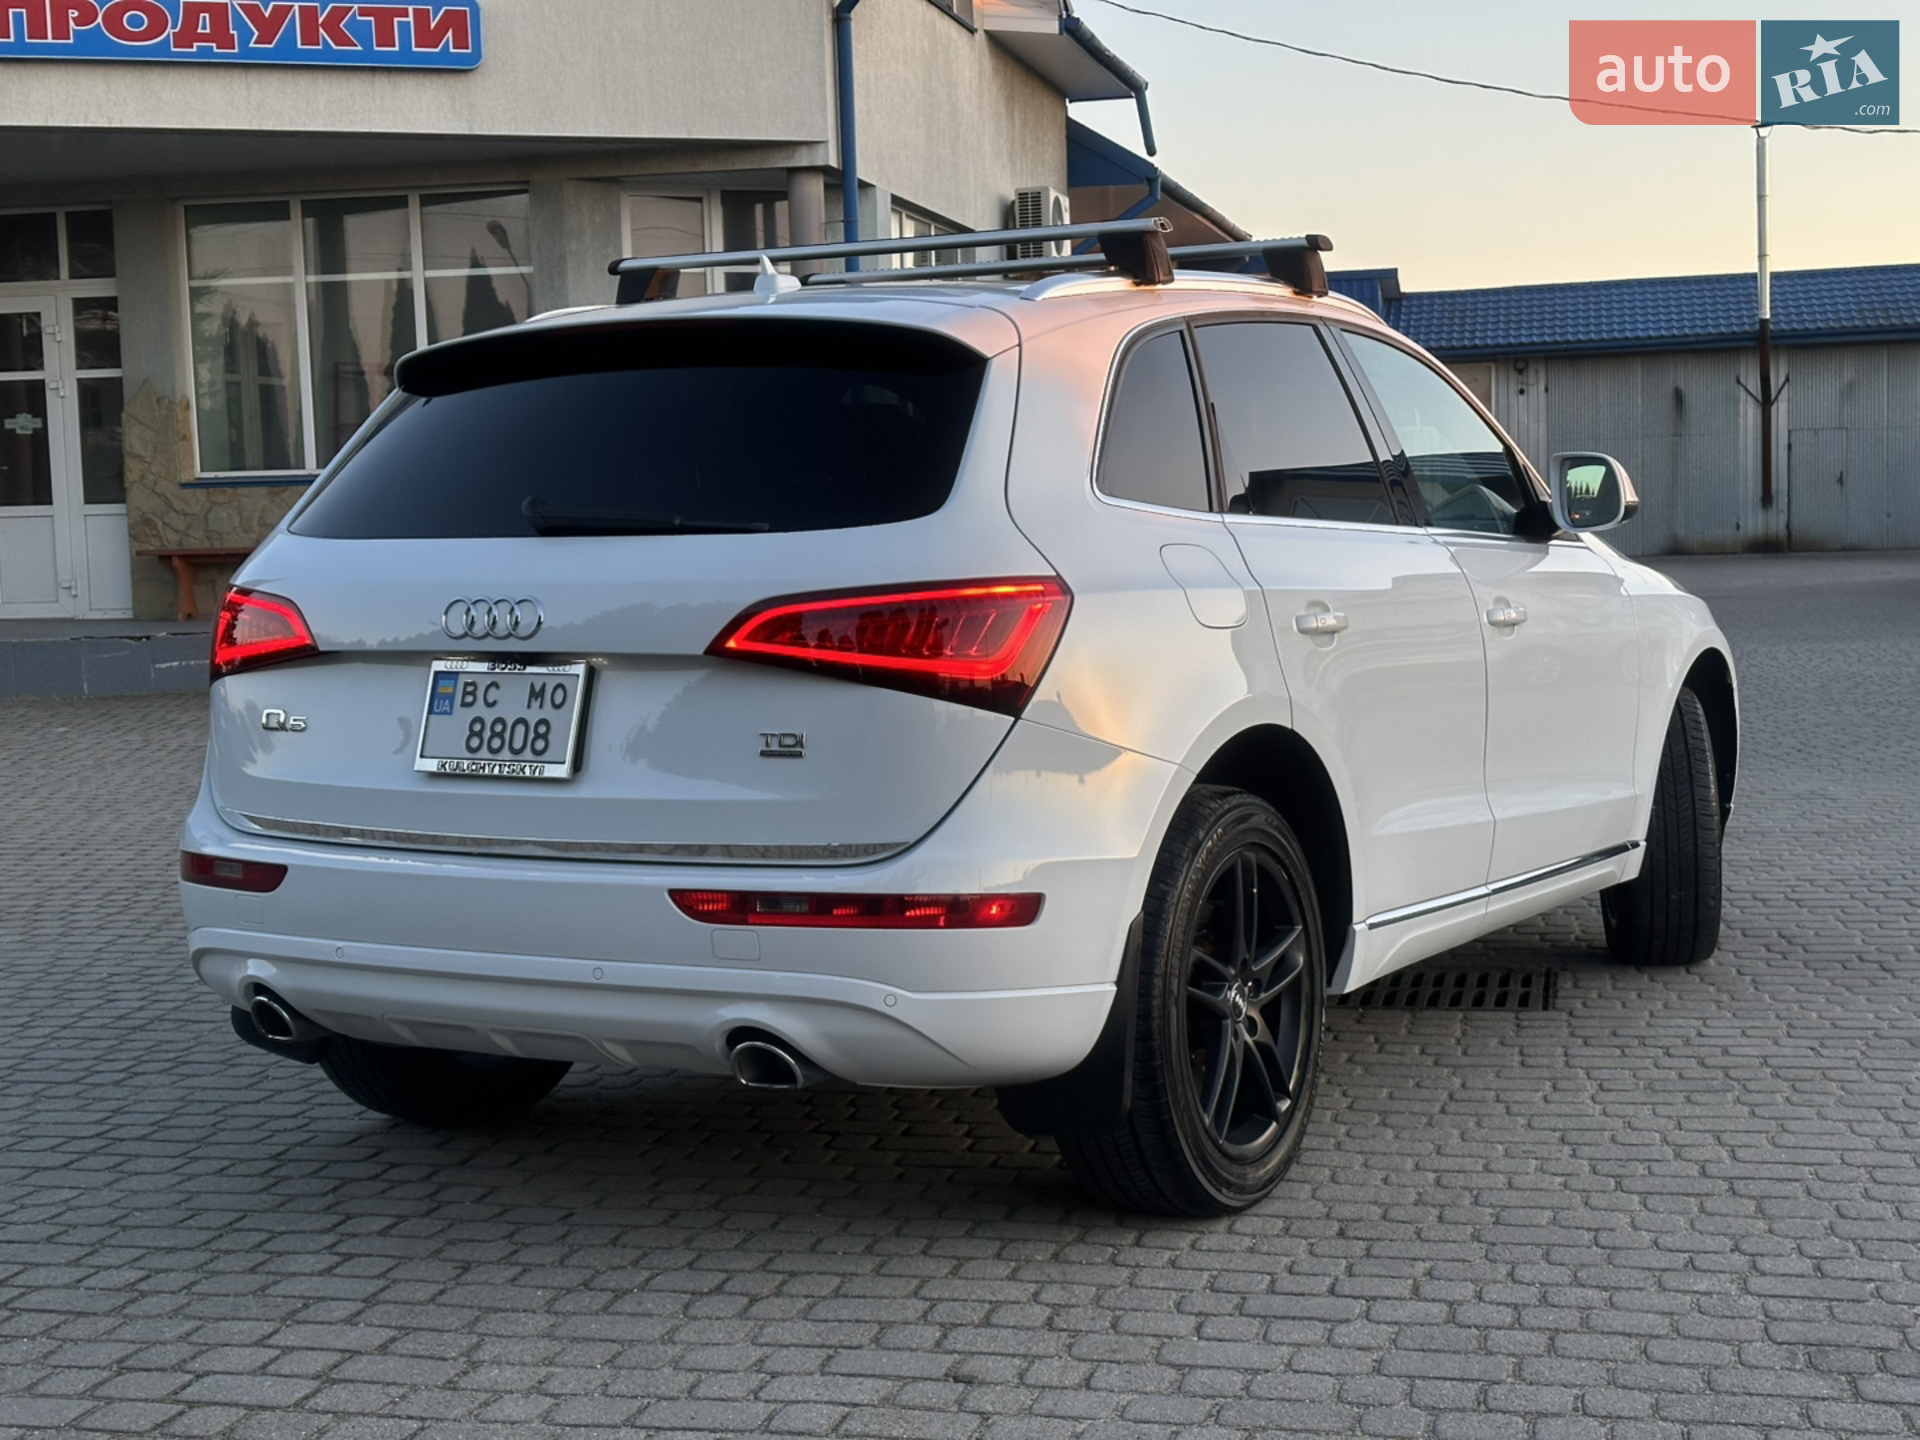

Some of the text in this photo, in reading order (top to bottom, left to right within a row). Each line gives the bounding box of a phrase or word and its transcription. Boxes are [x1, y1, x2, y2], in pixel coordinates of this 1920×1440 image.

[0, 0, 472, 52] ПРОДУКТИ
[433, 698, 451, 713] UA
[460, 679, 568, 710] BC MO
[261, 707, 308, 733] Q5
[465, 715, 552, 756] 8808
[758, 731, 807, 749] TDI
